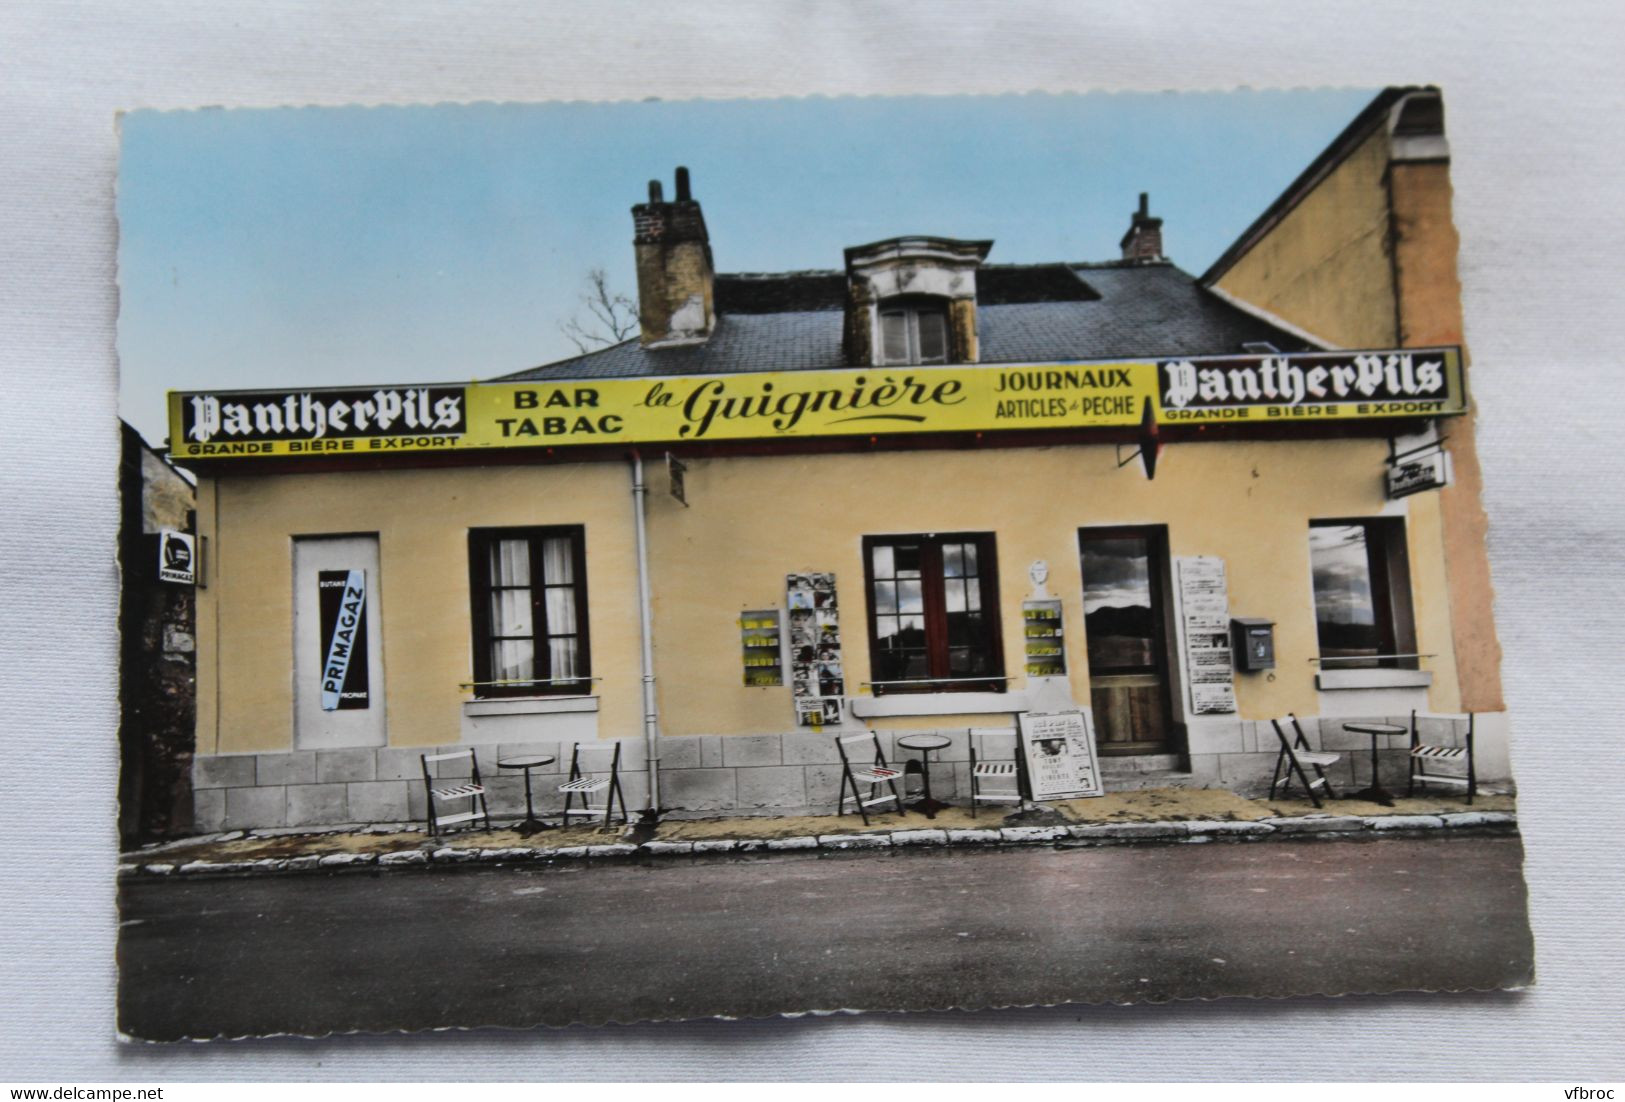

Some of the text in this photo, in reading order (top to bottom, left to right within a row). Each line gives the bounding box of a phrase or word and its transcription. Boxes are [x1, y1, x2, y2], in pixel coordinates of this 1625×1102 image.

[994, 368, 1133, 393] JOURNAUX
[514, 388, 600, 410] BAR
[633, 376, 966, 437] la Guignière
[995, 398, 1067, 418] ARTICLES
[1082, 395, 1135, 416] PECHE
[1165, 408, 1250, 420] GRANDE
[1357, 401, 1445, 415] EXPORT
[495, 414, 624, 437] TABAC
[188, 442, 274, 456] GRANDE
[370, 435, 461, 450] EXPORT
[161, 571, 194, 581] PRIMAGAZ
[324, 587, 363, 693] PRIMAGAZ
